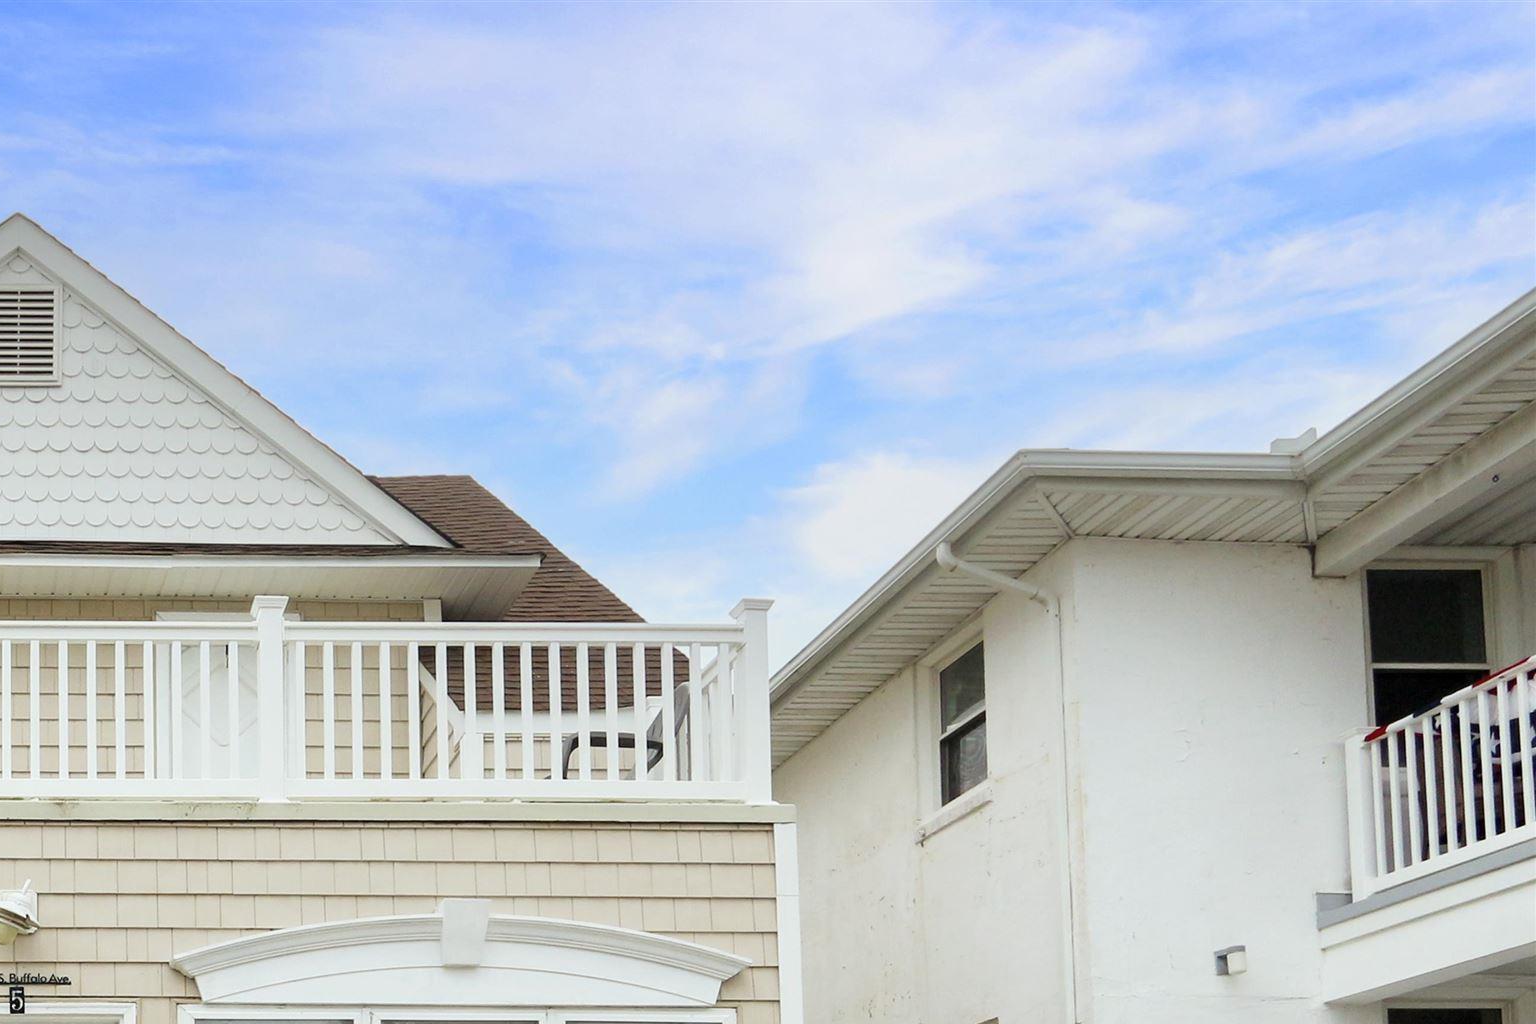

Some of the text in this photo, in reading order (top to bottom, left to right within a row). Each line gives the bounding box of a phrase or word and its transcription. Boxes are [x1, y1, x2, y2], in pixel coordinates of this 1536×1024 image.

[10, 973, 47, 983] Buffalo
[48, 974, 71, 984] Ave.
[11, 990, 23, 1010] 5
